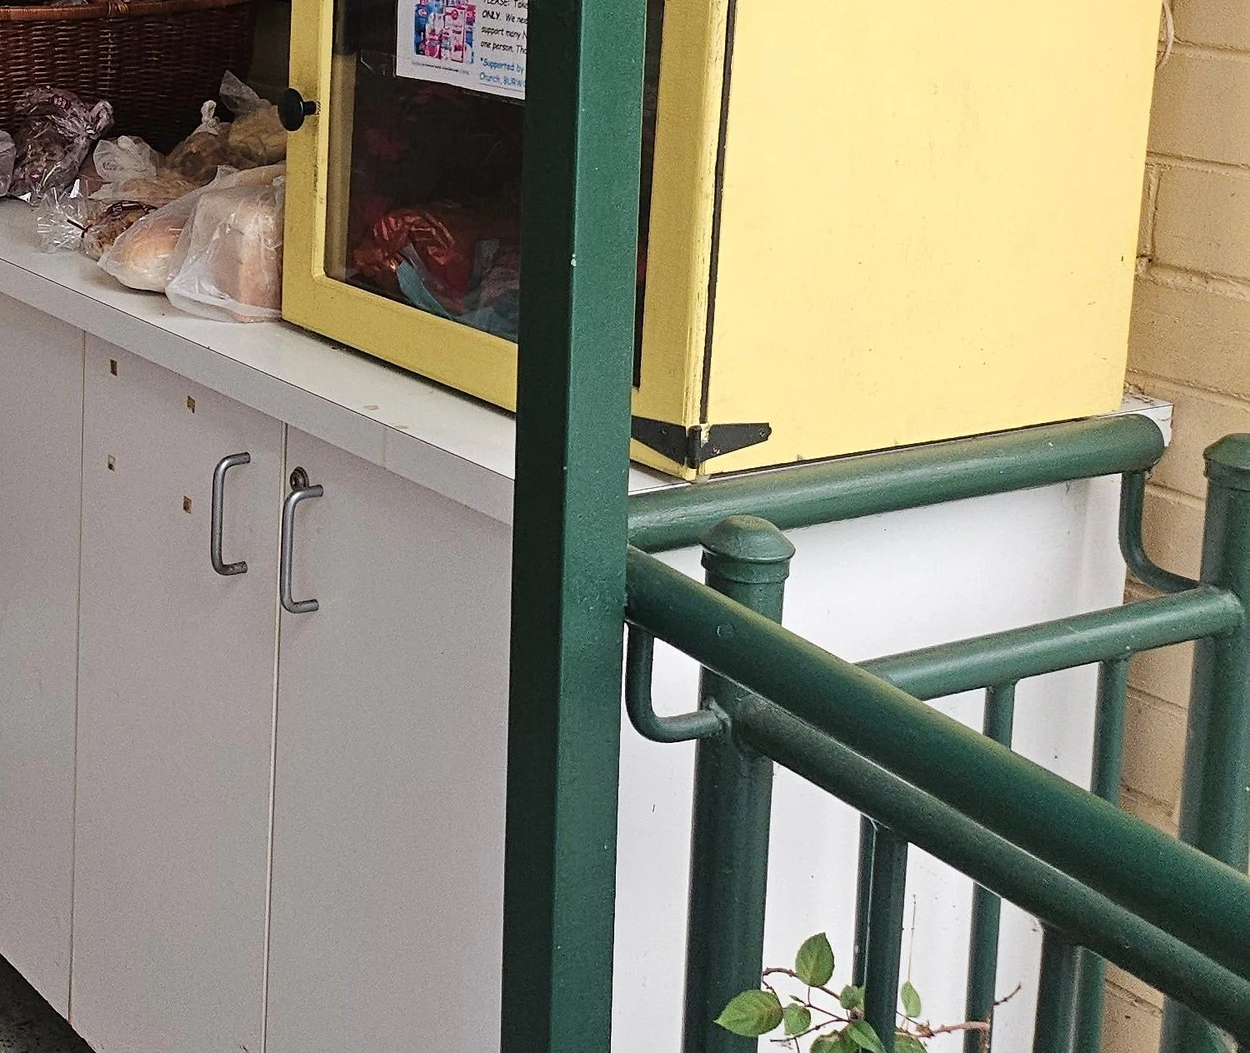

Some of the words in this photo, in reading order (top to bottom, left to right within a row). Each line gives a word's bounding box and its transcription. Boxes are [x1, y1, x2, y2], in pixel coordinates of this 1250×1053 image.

[506, 13, 514, 22] We
[481, 26, 504, 36] support
[517, 64, 524, 75] by
